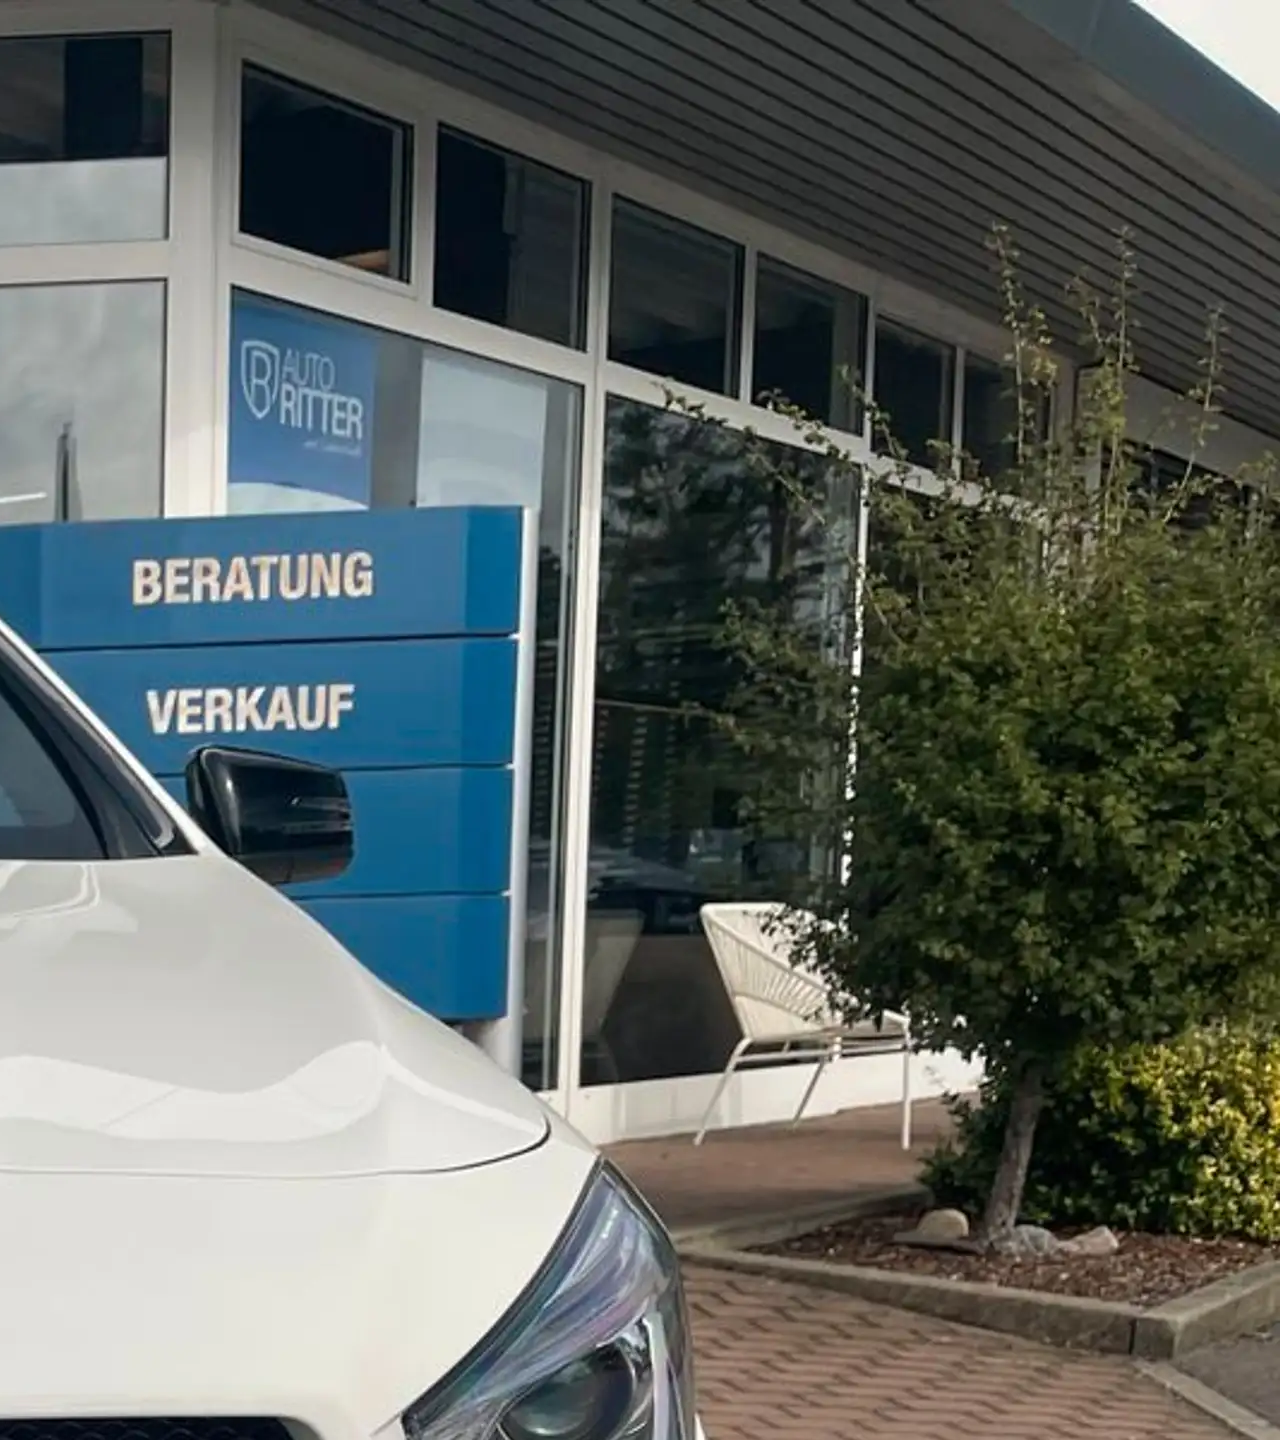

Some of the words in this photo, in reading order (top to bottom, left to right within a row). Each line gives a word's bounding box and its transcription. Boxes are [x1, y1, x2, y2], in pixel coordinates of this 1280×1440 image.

[282, 348, 336, 390] AUTO
[279, 383, 363, 440] RITTER
[132, 551, 374, 605] BERATUNG
[146, 684, 355, 734] VERKAUF
